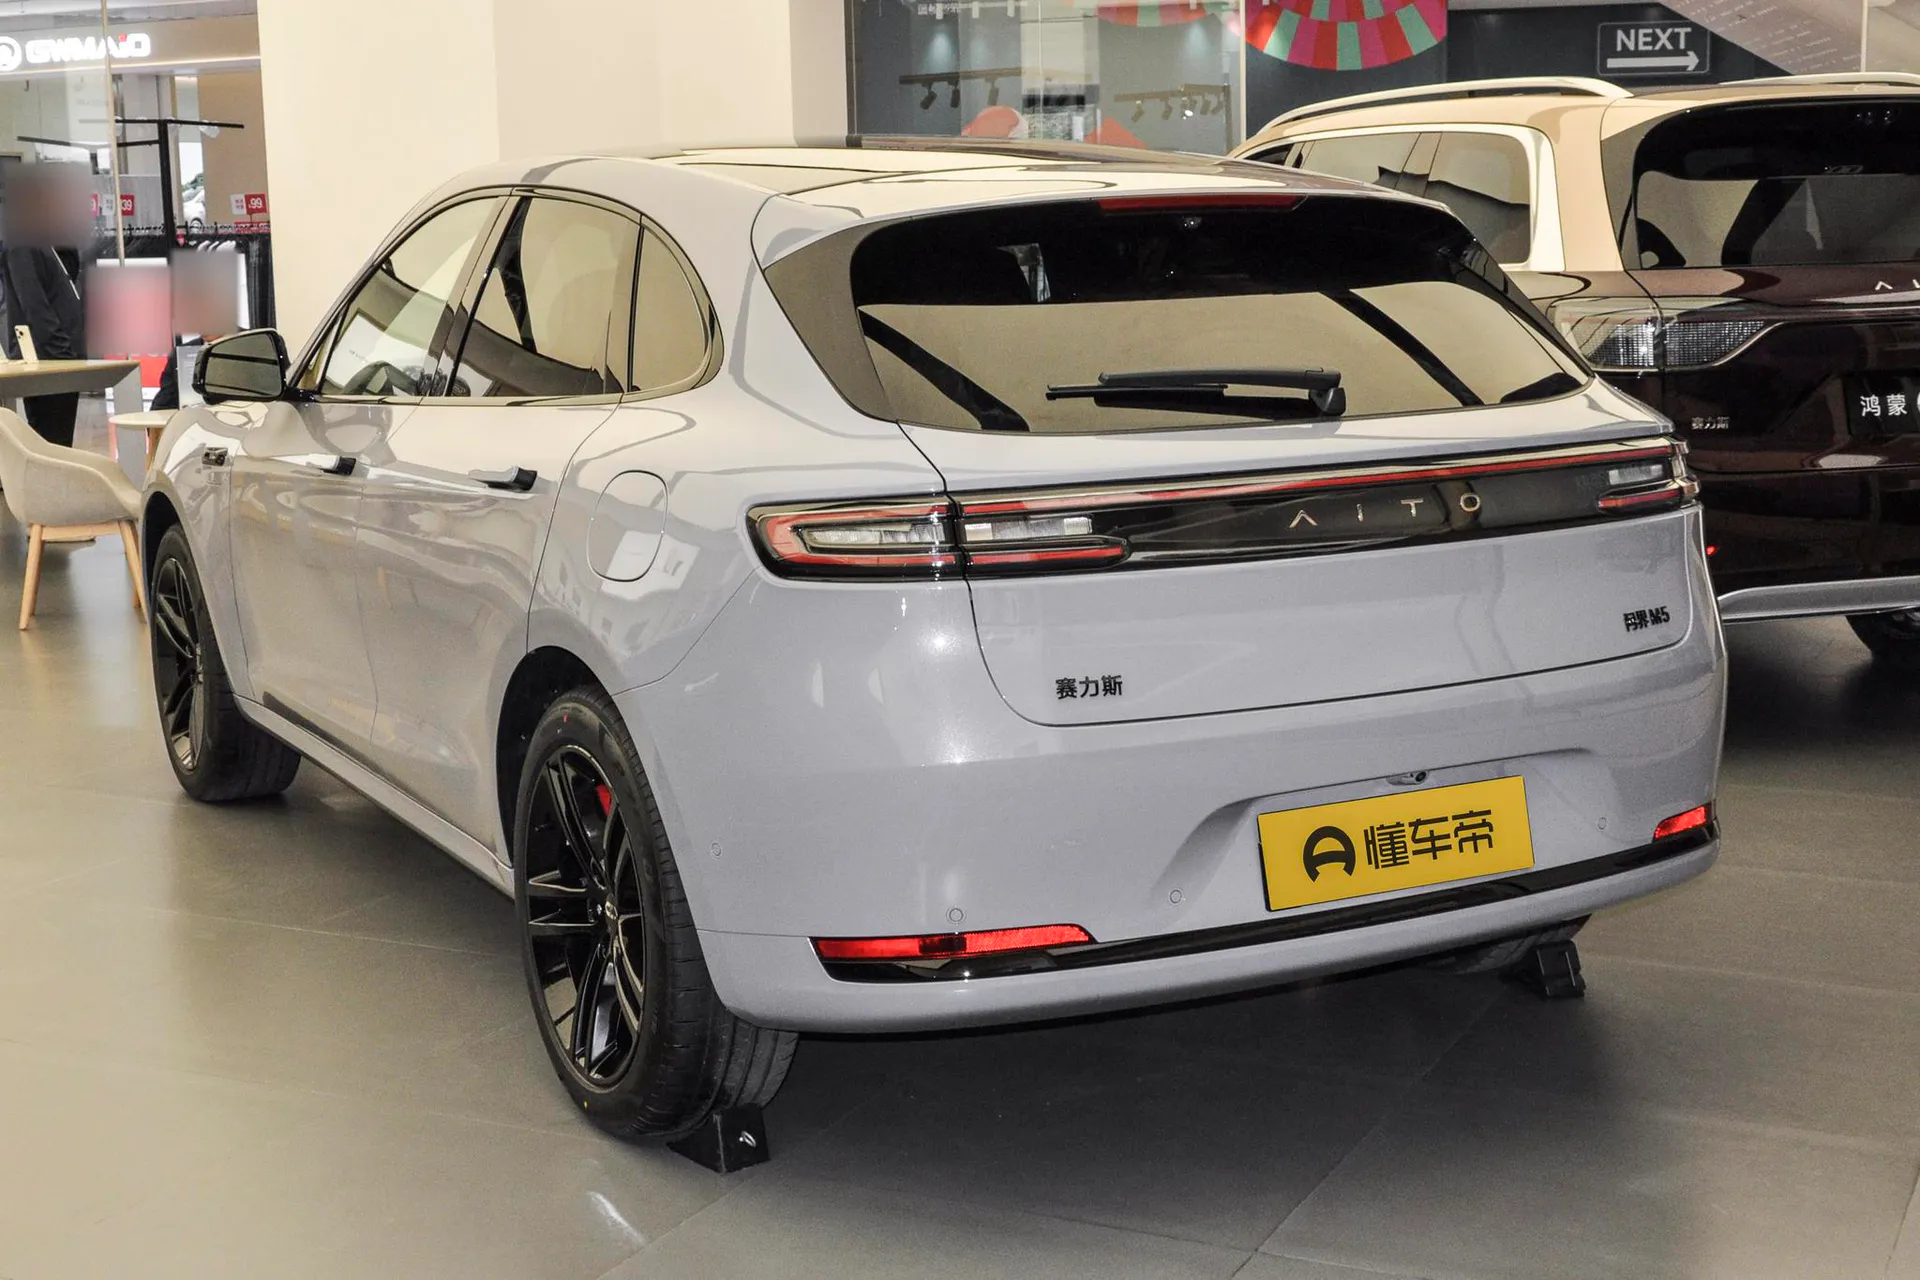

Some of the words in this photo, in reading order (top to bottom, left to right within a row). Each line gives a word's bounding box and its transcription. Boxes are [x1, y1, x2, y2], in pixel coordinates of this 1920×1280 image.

[1616, 27, 1692, 51] NEXT
[1860, 394, 1908, 417] 鸿蒙
[1289, 493, 1481, 529] AITO
[1055, 674, 1123, 700] 赛力斯
[1363, 809, 1494, 870] 懂车帝
